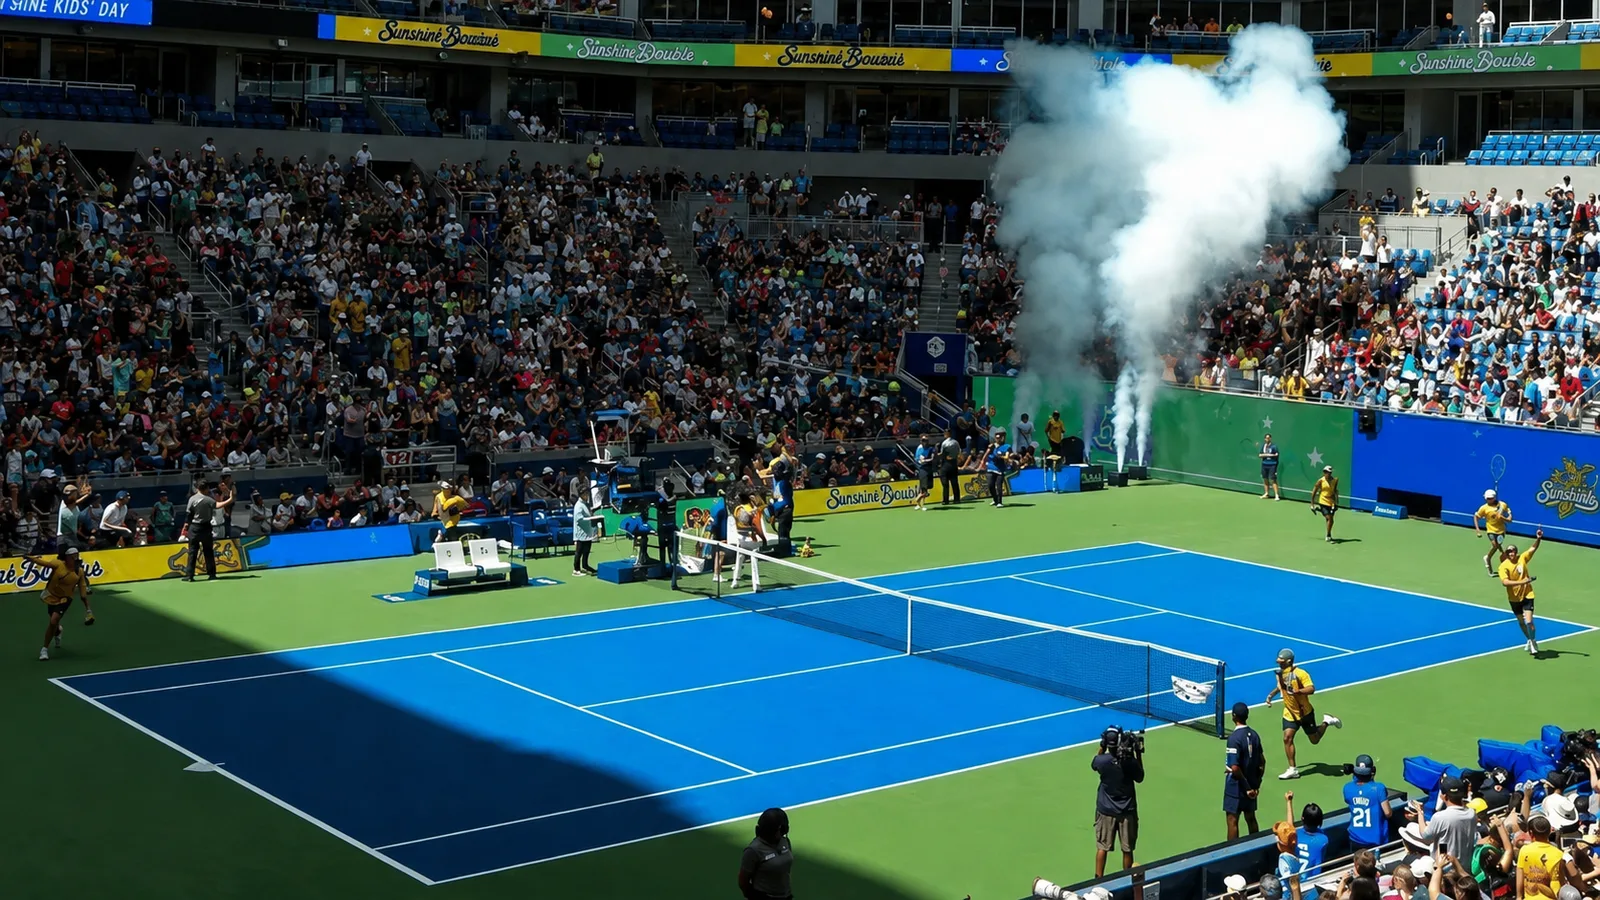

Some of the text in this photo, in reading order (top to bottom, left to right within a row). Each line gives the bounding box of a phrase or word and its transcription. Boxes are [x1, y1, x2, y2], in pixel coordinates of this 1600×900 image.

[98, 2, 130, 18] DAY
[577, 37, 695, 63] Sunshine Double
[1409, 50, 1536, 74] Sunshine Double
[1353, 807, 1372, 828] 21
